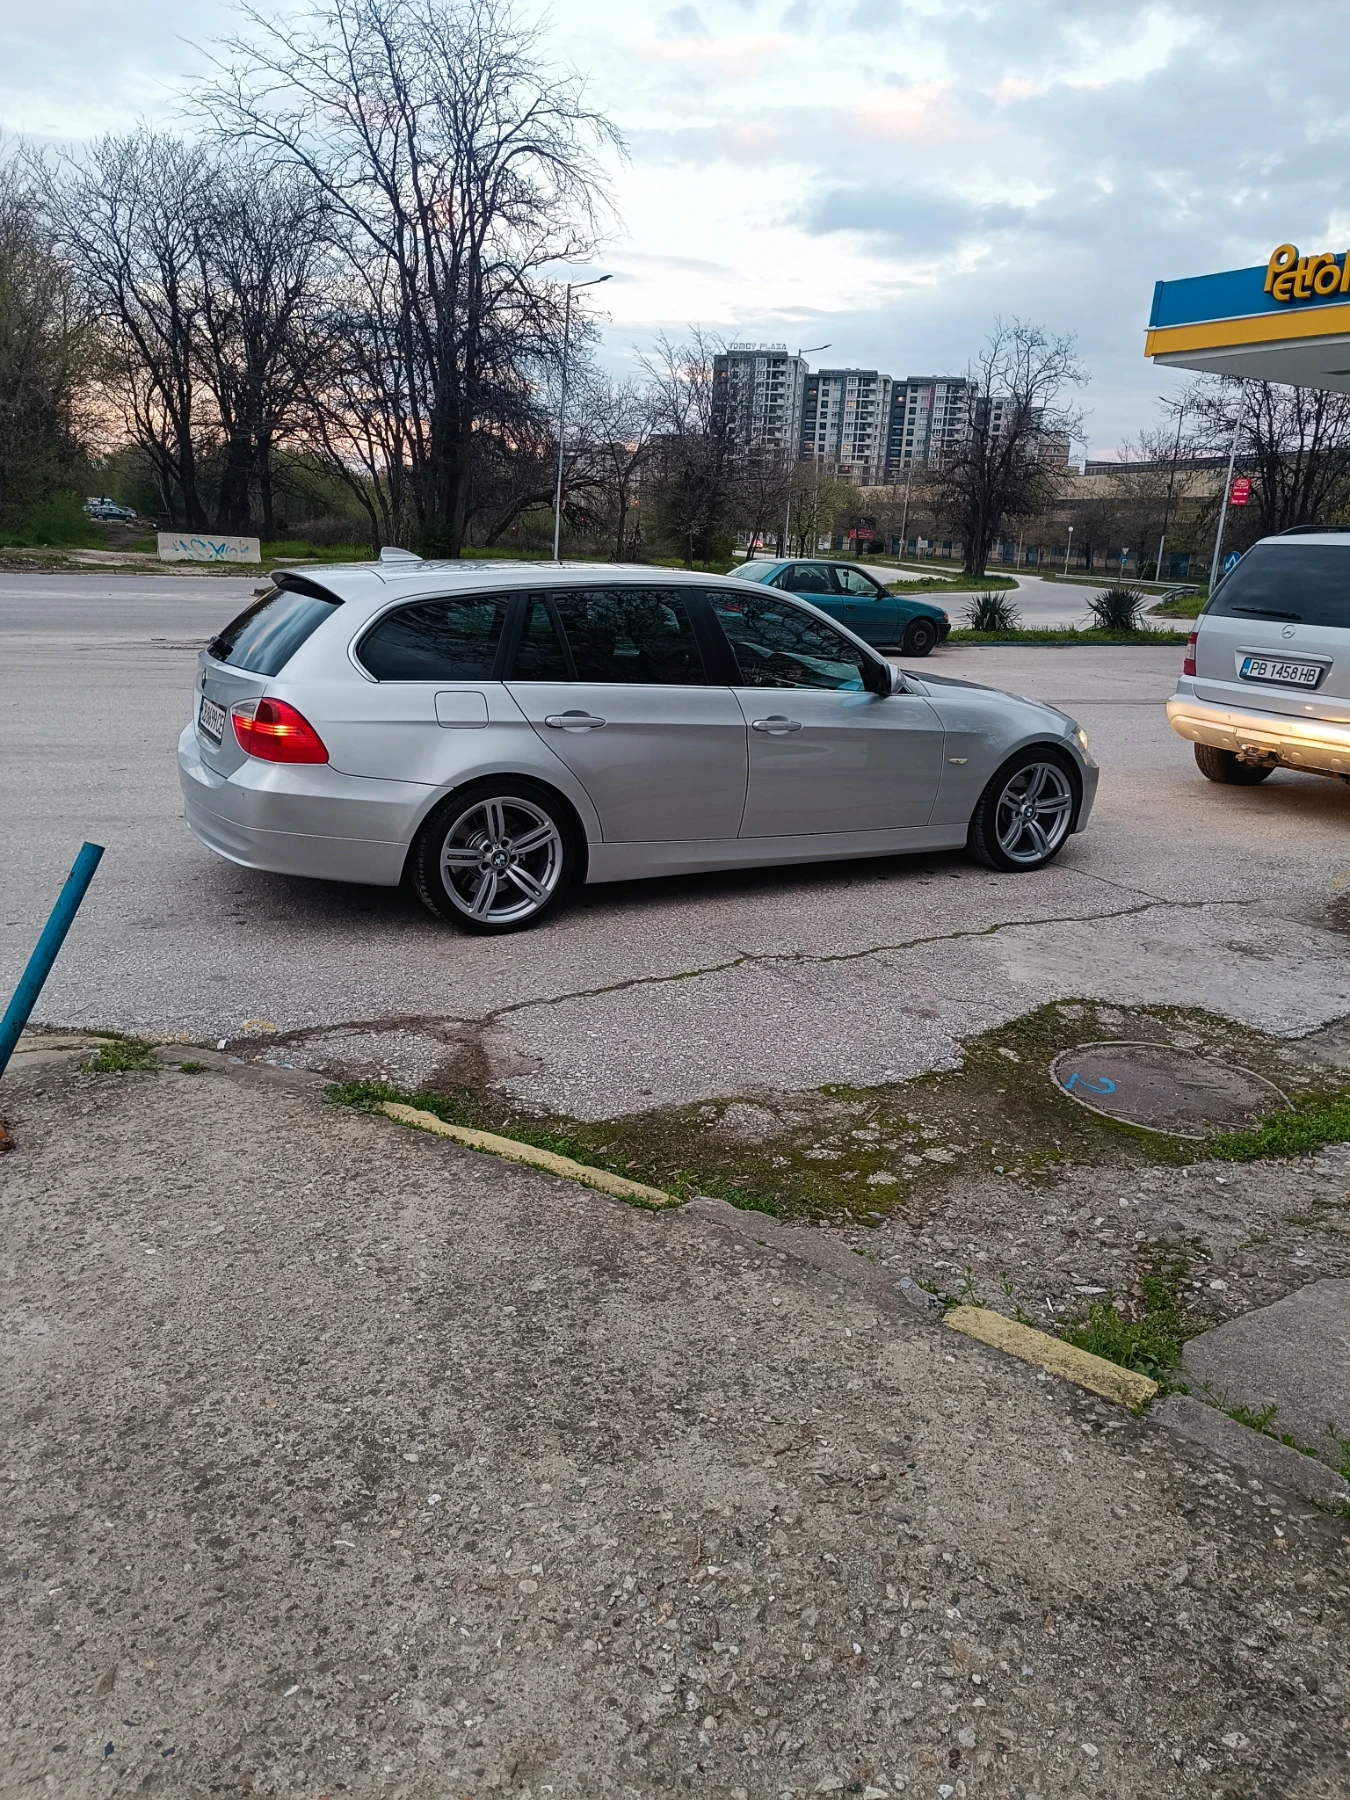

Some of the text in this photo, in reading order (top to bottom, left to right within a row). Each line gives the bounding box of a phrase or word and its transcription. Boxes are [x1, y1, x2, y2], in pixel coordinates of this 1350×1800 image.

[1250, 661, 1316, 682] PB 1458 HB
